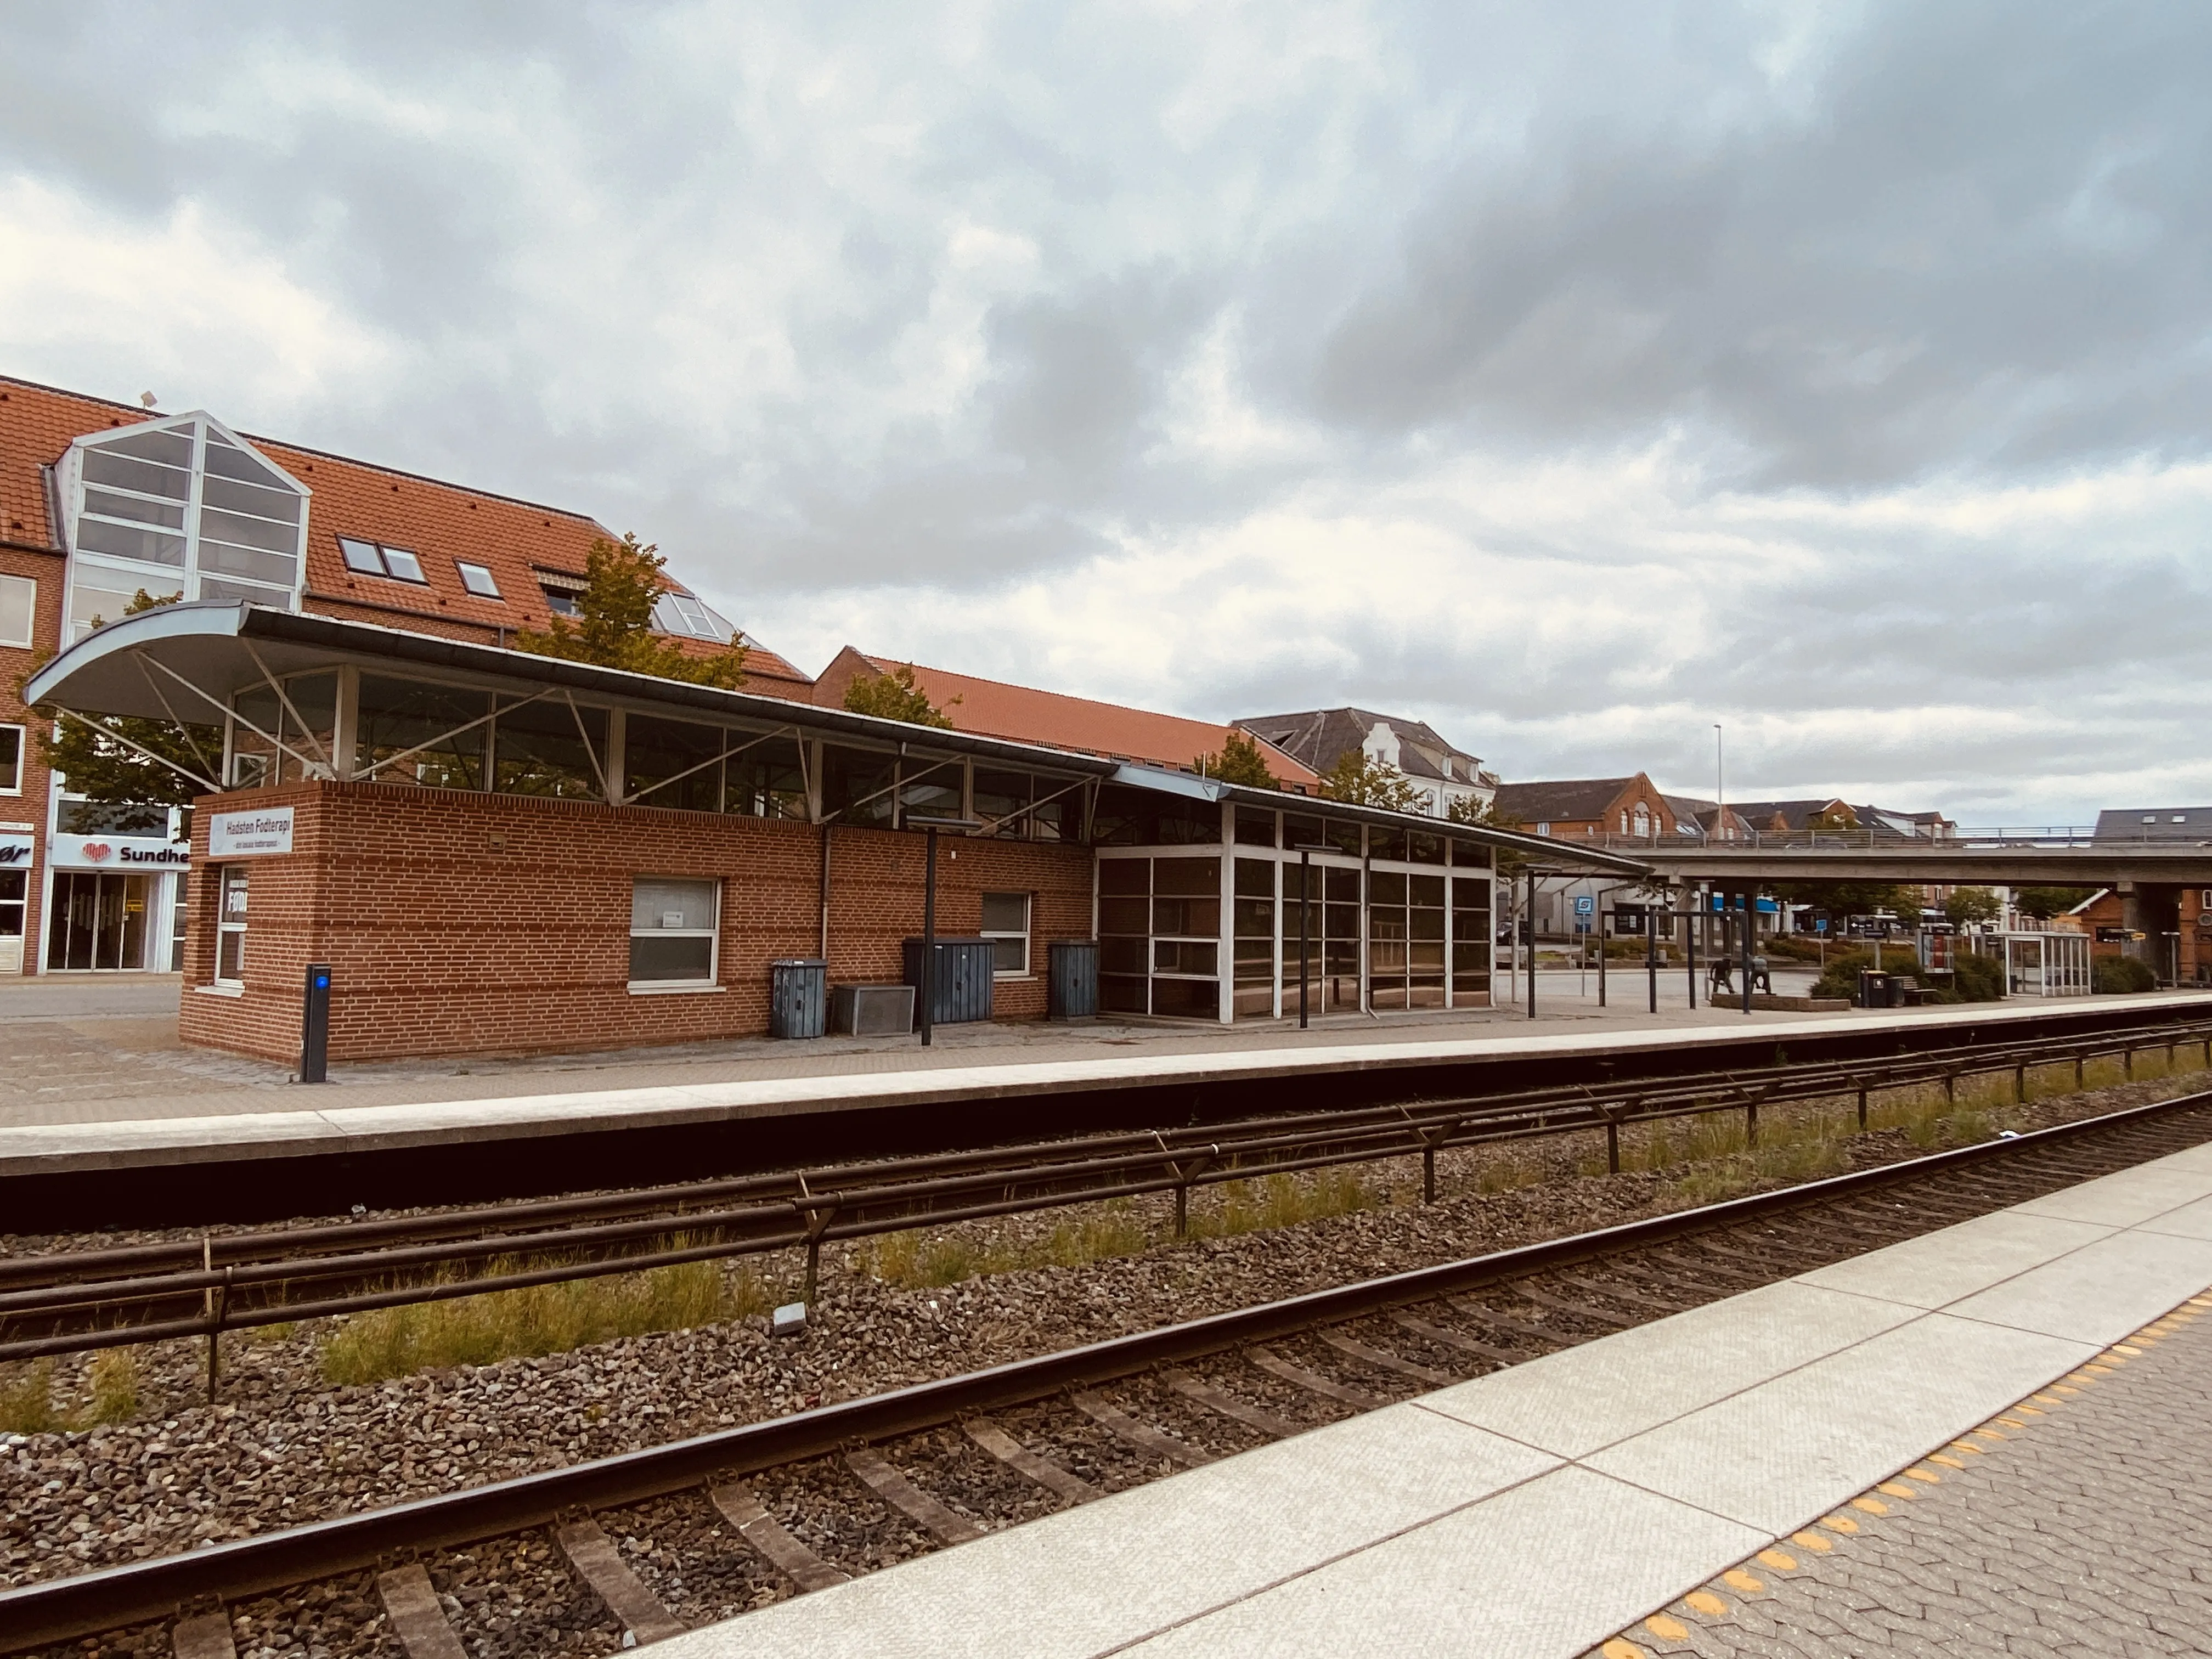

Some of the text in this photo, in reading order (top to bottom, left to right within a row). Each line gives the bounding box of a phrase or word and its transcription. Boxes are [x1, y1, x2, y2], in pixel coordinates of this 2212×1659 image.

[226, 816, 290, 835] Hadsten Fodterapi
[120, 847, 189, 863] Sundhe
